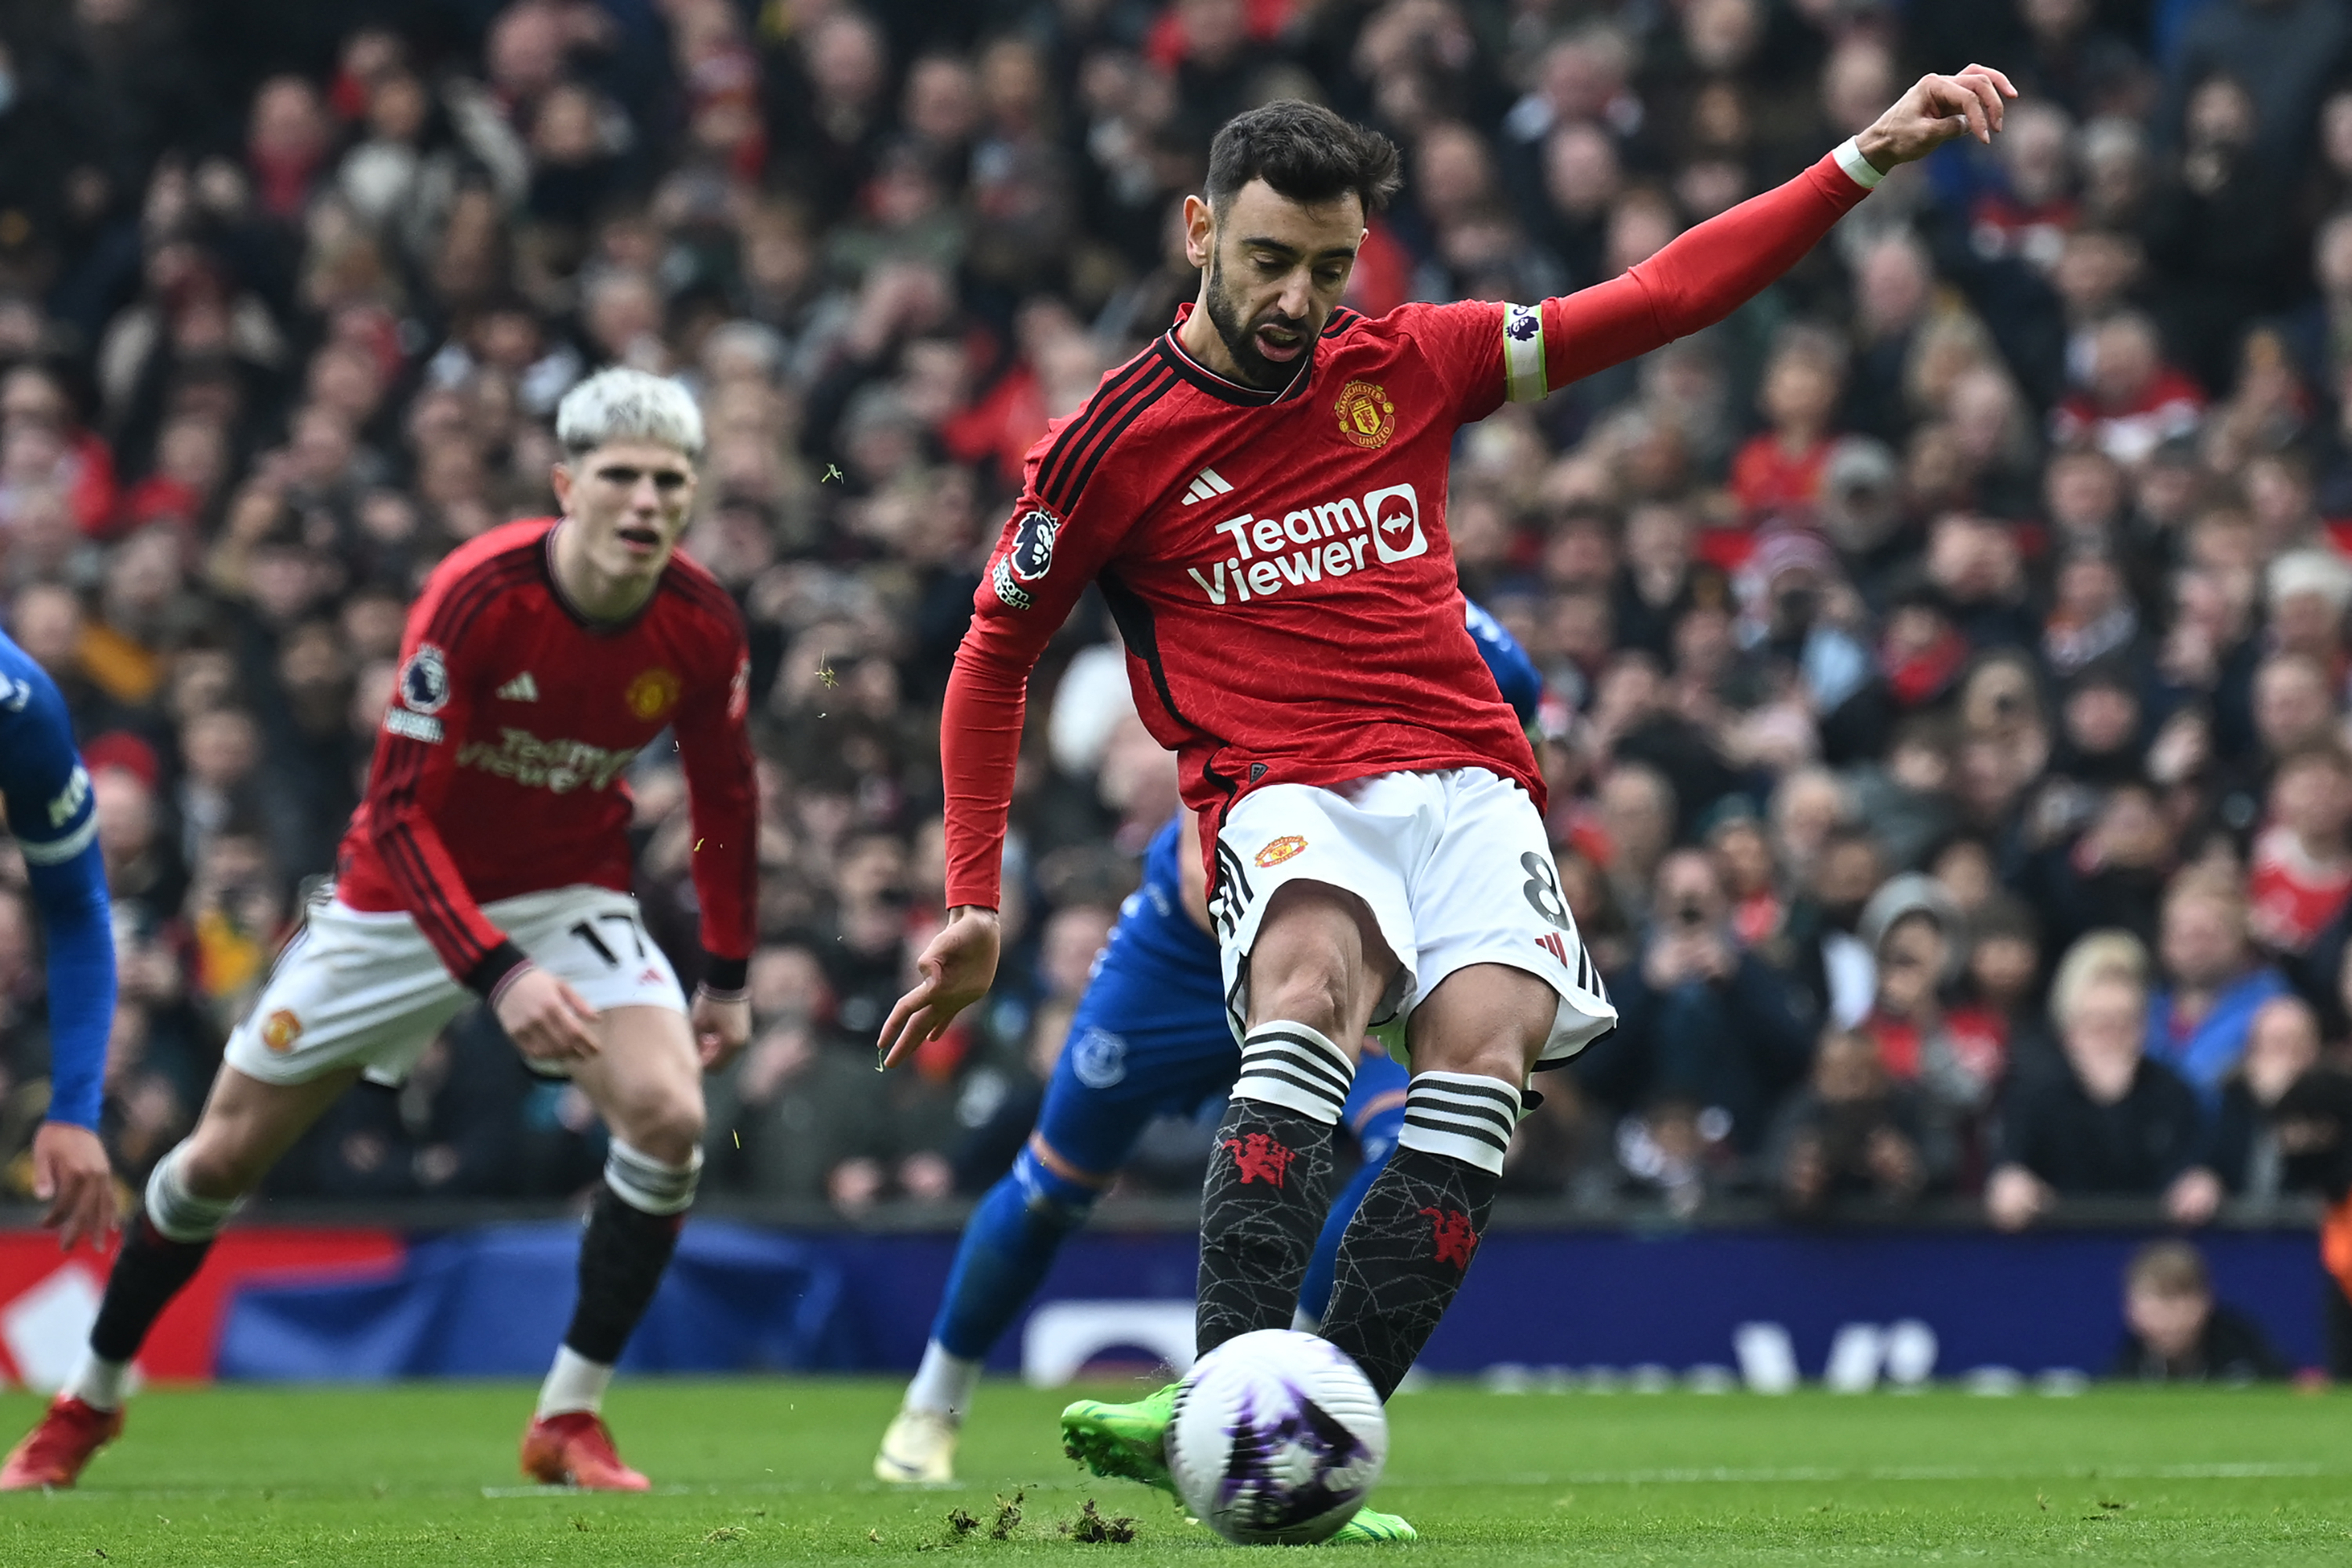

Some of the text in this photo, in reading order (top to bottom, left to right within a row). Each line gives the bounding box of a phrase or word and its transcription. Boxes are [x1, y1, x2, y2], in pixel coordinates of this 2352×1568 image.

[1339, 384, 1382, 415] MANCHESTER
[1359, 426, 1390, 445] UNITED
[1214, 497, 1367, 561] Team
[1186, 533, 1370, 605] Viewer
[1519, 851, 1571, 931] 8
[569, 913, 646, 967] 17
